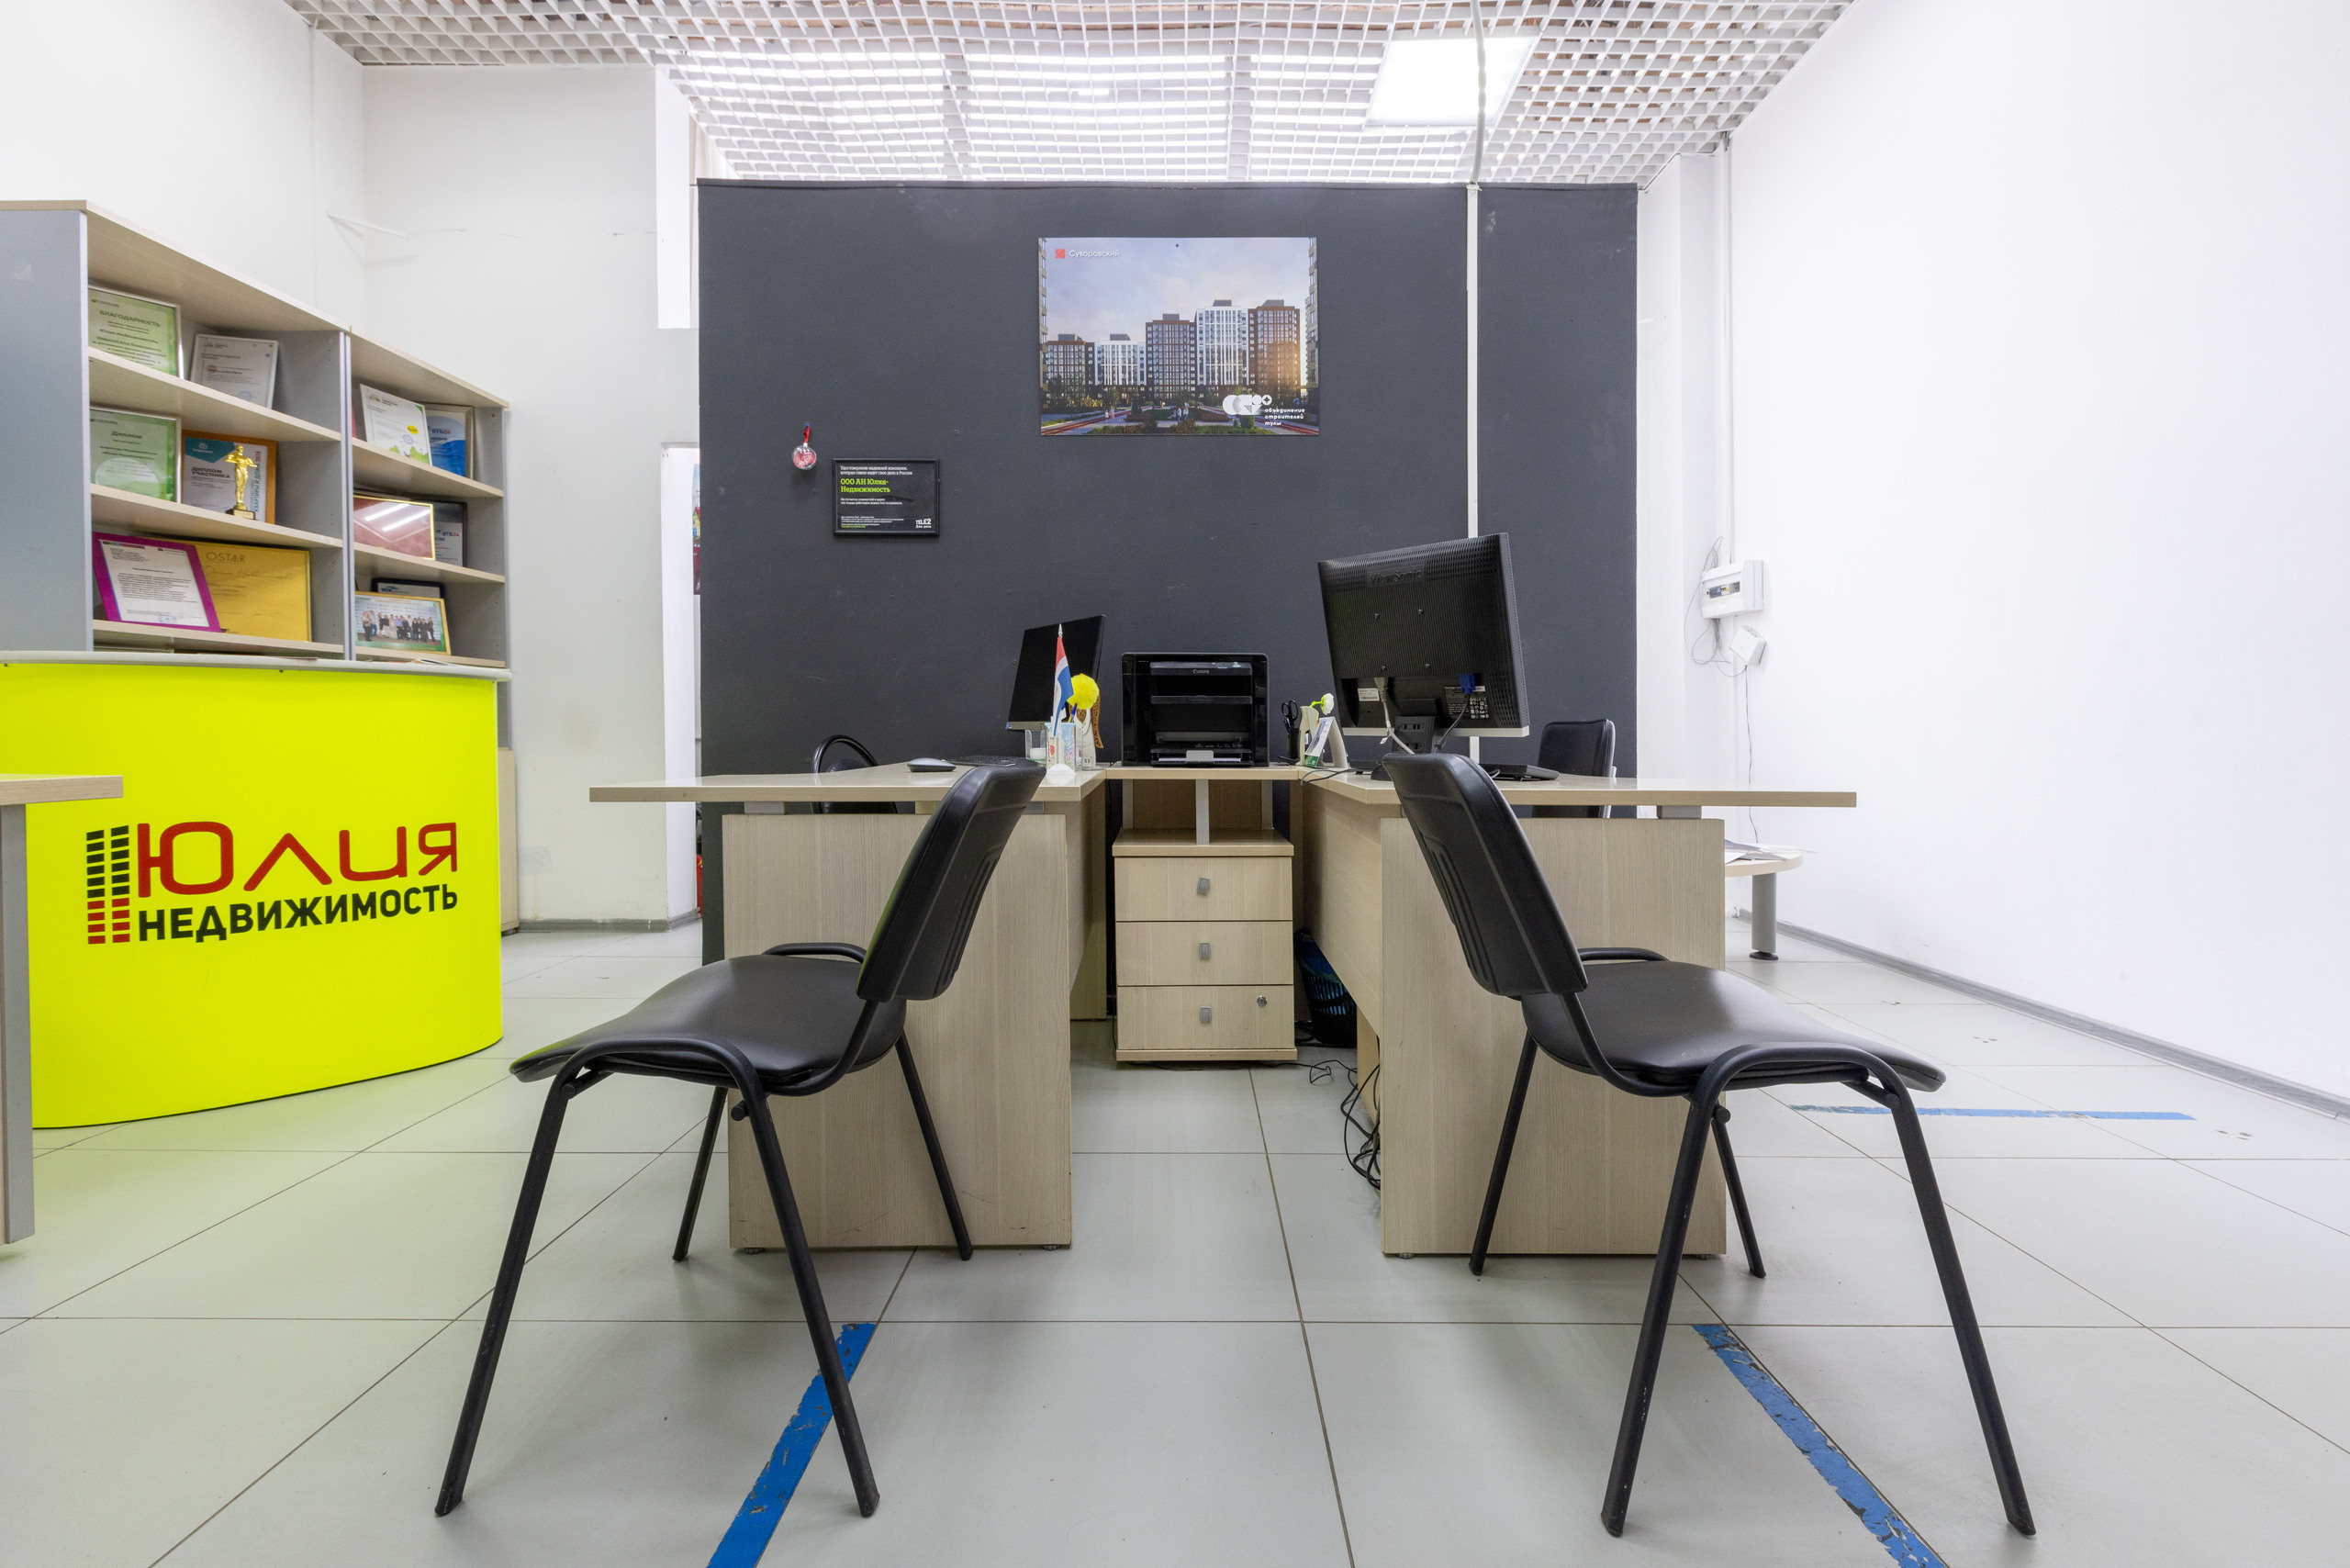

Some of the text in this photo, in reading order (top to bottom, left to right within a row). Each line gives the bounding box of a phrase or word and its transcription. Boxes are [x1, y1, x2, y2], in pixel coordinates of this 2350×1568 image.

[1069, 250, 1120, 258] Суворовский
[99, 310, 162, 328] БЛАГОДАРНОСТЬ
[206, 552, 246, 563] OSTAR
[1370, 568, 1425, 585] ViewSonic
[138, 883, 458, 943] НЕДВИЖИМОСТЬ
